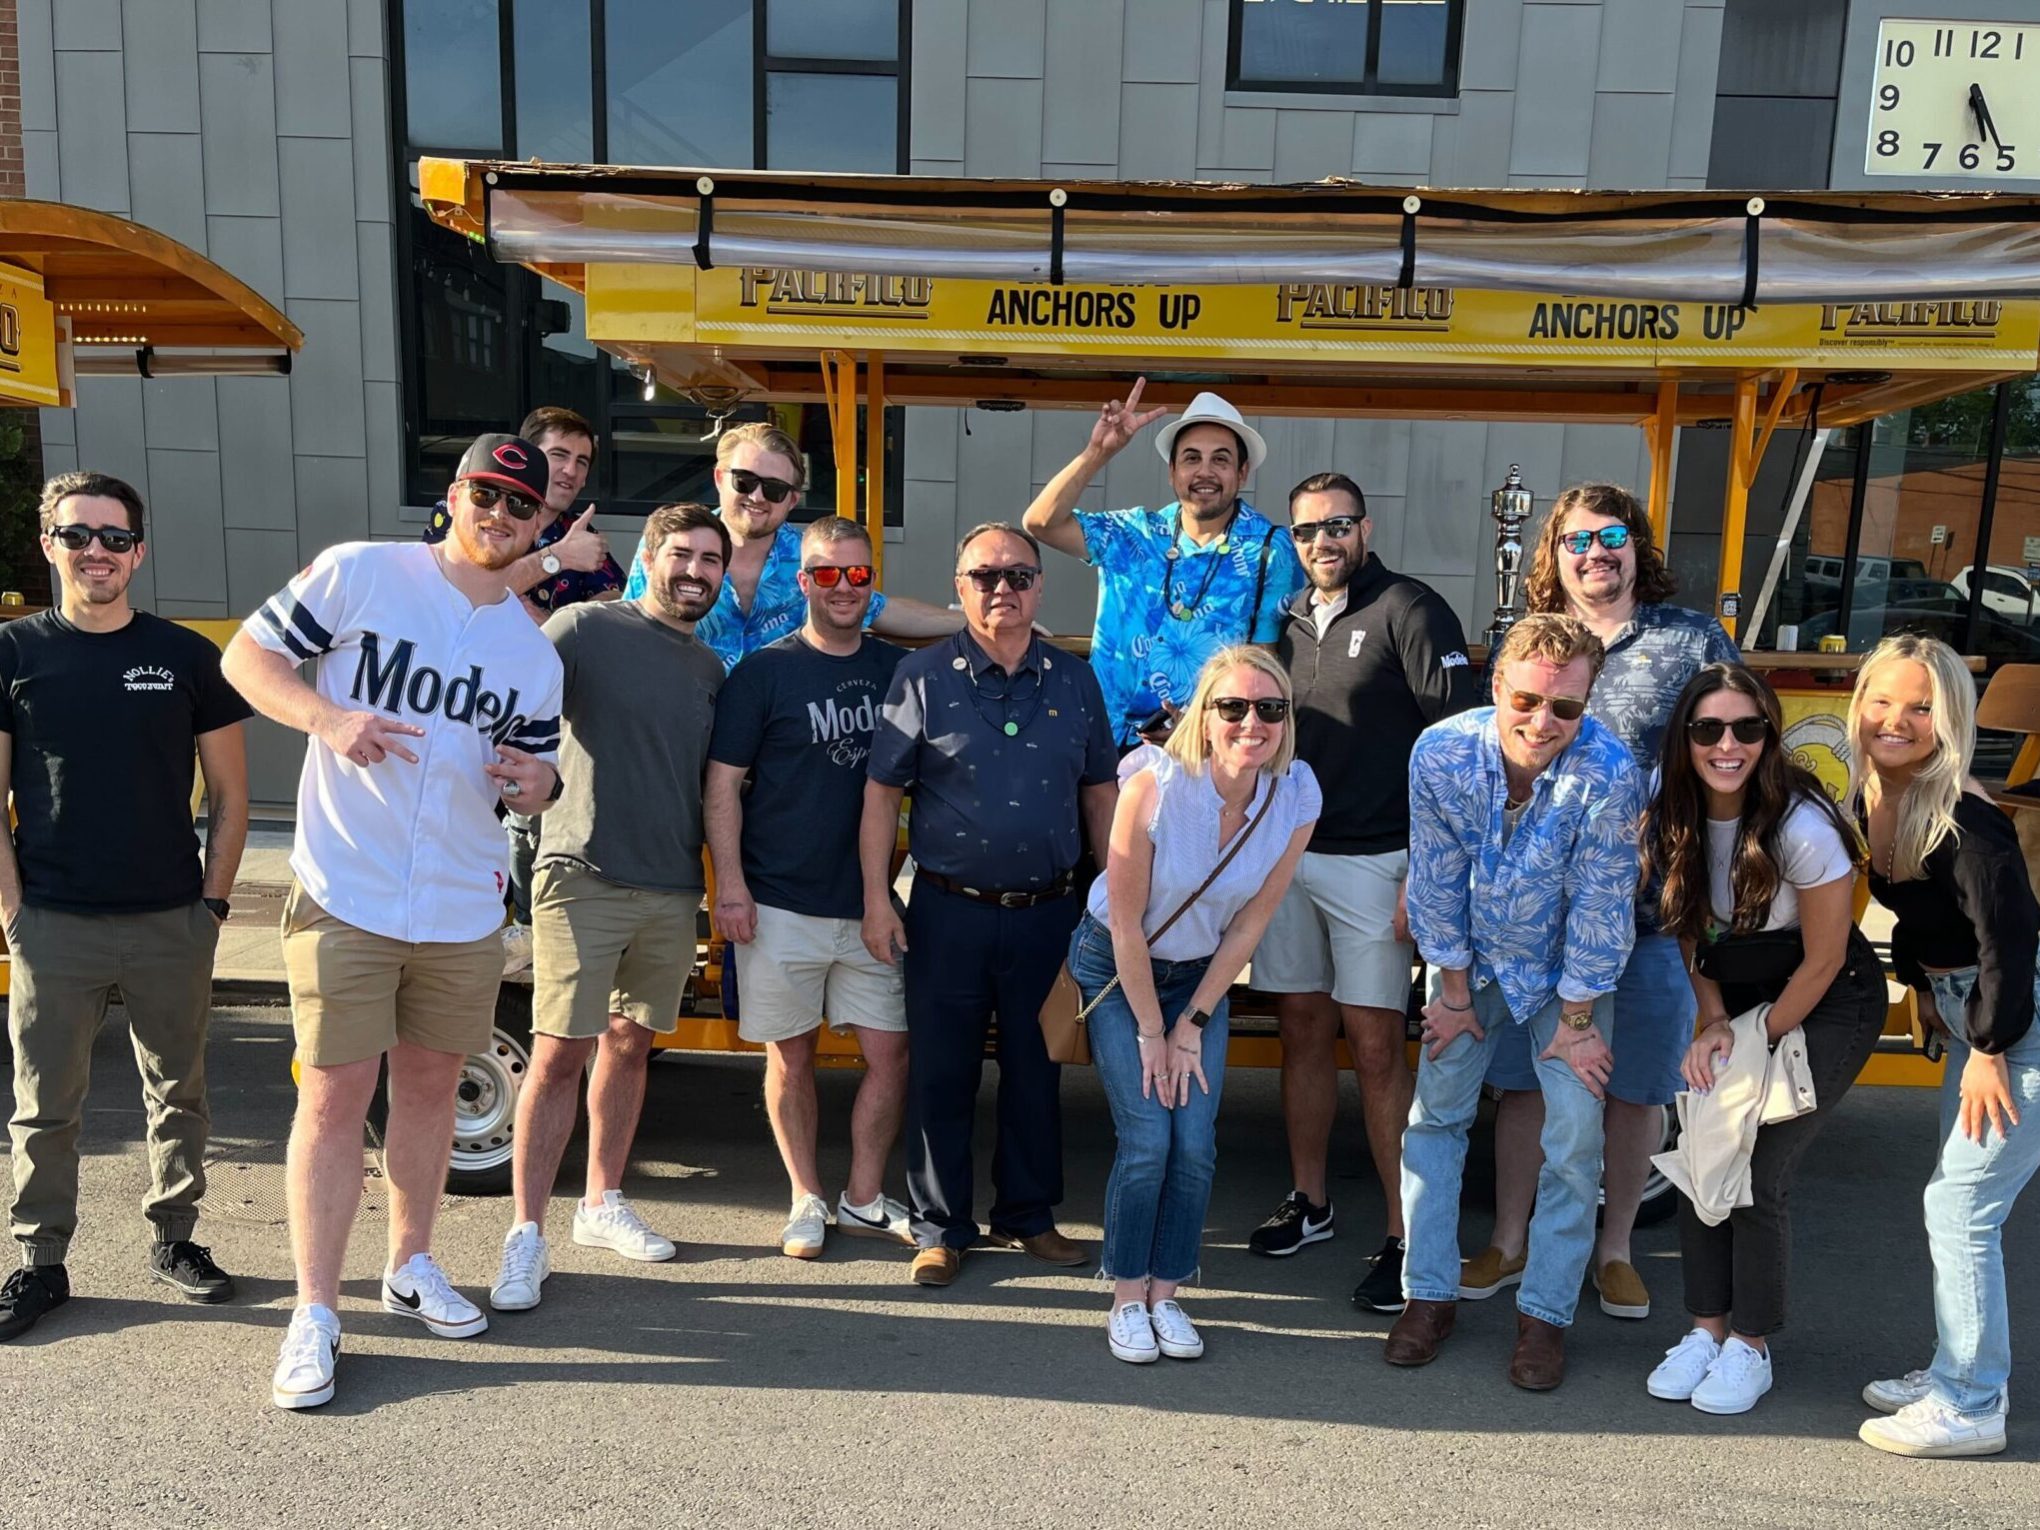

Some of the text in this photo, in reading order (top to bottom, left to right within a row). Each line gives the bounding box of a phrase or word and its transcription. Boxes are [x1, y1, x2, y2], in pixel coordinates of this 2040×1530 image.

[1885, 39, 1915, 67] 10
[1934, 29, 2023, 60] 11 12 1
[1879, 84, 1900, 111] 9
[1876, 129, 1900, 157] 8
[1922, 142, 2015, 171] 7 6 5
[986, 289, 1201, 330] ANCHORS UP
[1276, 284, 1454, 322] PACIFICO
[1528, 303, 1746, 340] ANCHORS UP
[836, 679, 878, 693] CERVEZA
